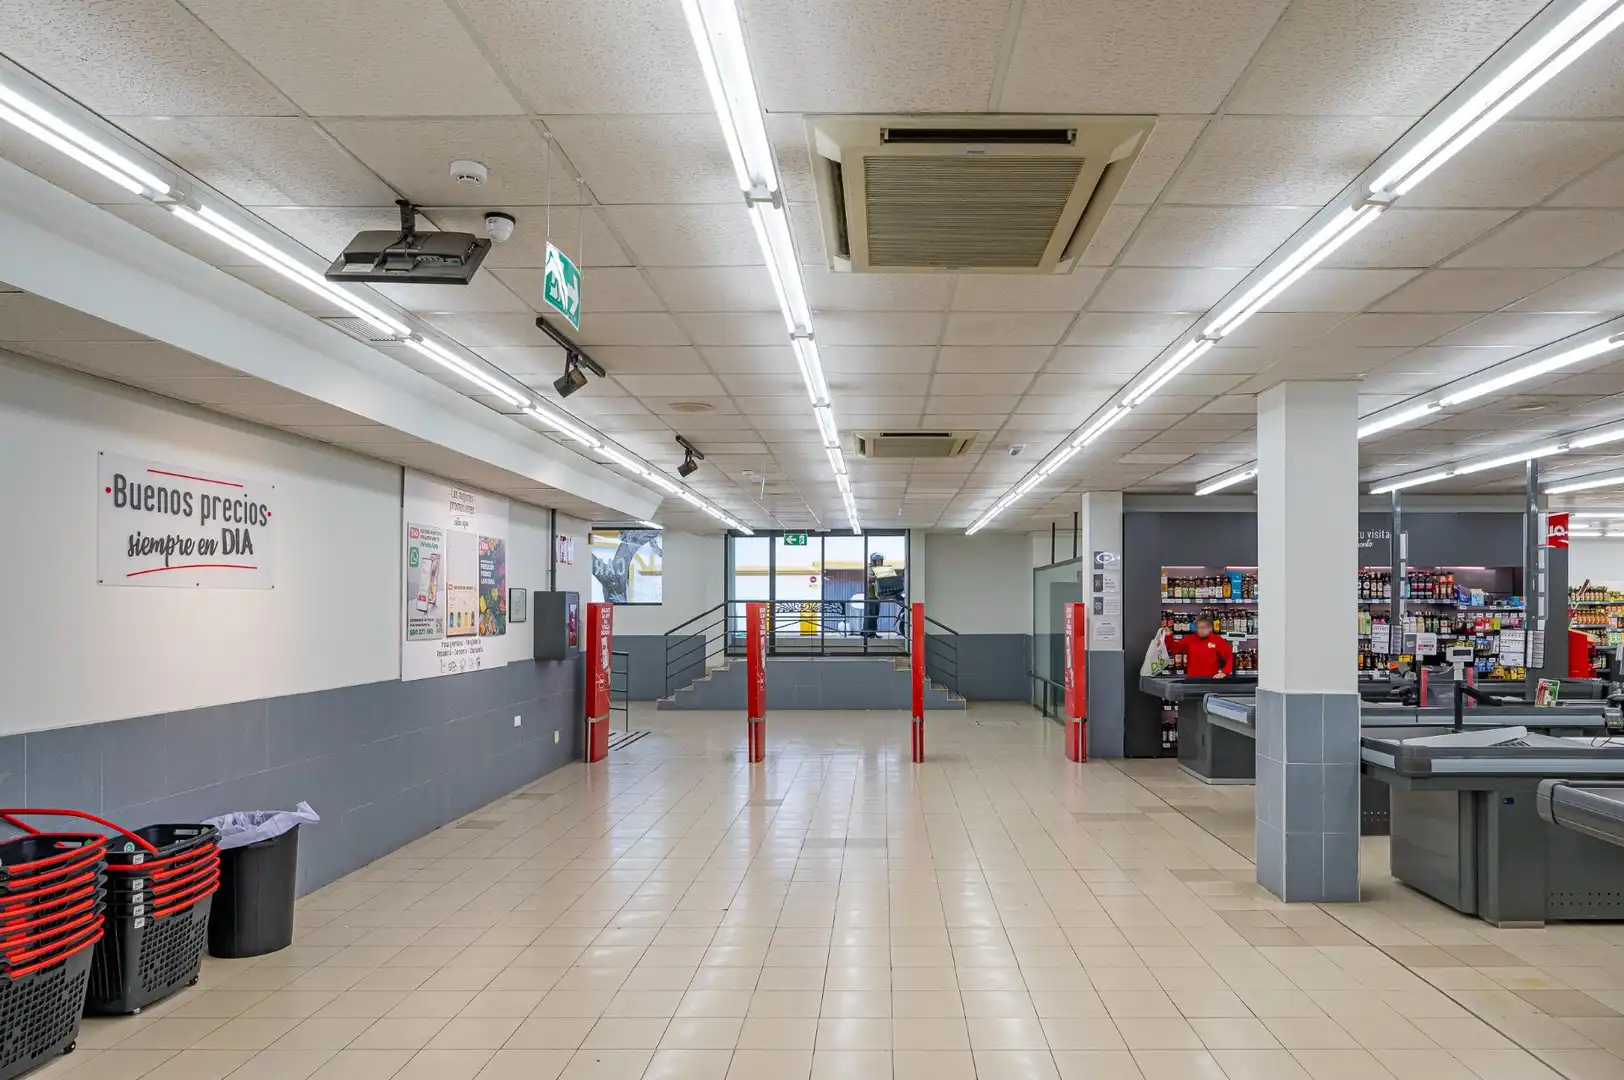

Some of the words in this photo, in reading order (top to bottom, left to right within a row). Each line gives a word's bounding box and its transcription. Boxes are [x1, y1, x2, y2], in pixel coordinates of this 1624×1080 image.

[114, 473, 193, 517] Buenos
[201, 493, 268, 527] precios
[128, 531, 195, 567] siempre
[198, 538, 218, 556] en
[222, 528, 253, 555] DIA
[1367, 529, 1390, 539] visita
